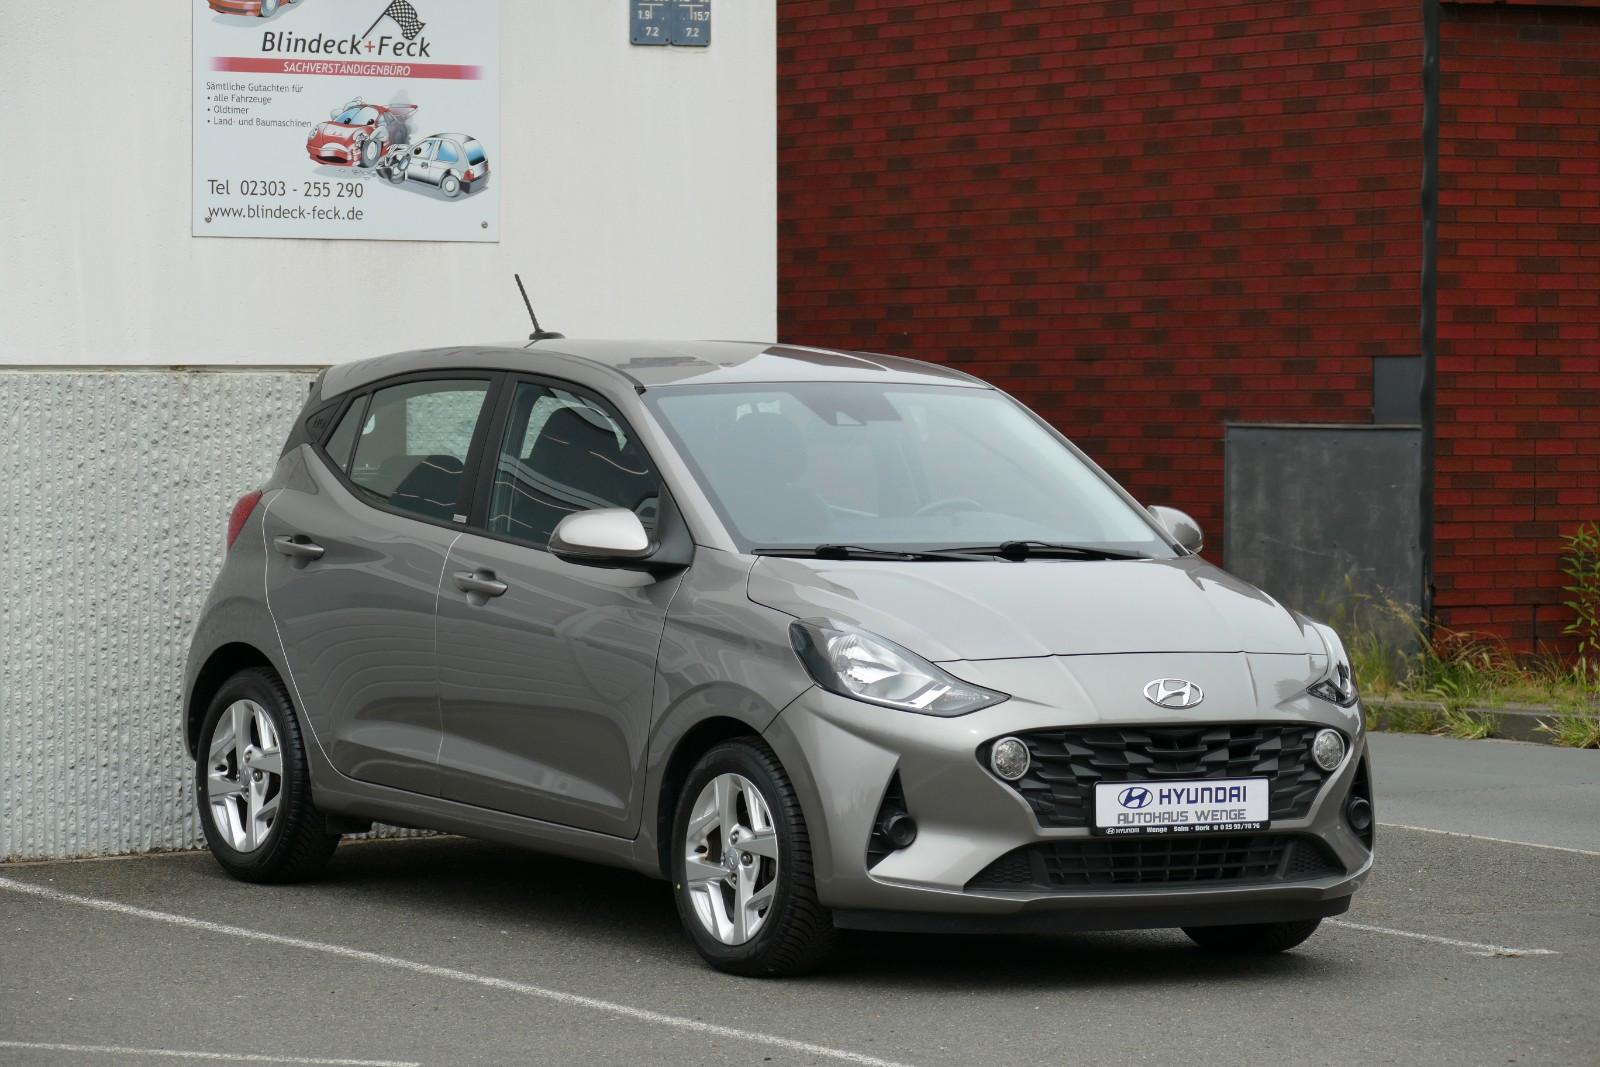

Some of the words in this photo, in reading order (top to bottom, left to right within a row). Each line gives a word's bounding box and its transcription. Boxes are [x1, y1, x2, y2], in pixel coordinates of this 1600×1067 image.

[283, 61, 411, 77] SACHVERSTÄNDIGENBÜRO
[206, 82, 246, 92] Sämtliche
[248, 83, 290, 93] Gutachten
[292, 84, 304, 93] für
[213, 94, 229, 103] alle
[231, 95, 272, 105] Fahrzeuge
[213, 105, 249, 115] Oldtimer
[238, 118, 254, 127] und
[256, 118, 312, 128] Baumaschinen
[208, 179, 231, 195] Tel
[240, 180, 286, 197] 02303
[303, 181, 331, 198] 255
[336, 182, 364, 198] 290
[208, 204, 364, 221] www.blindeck-feck.de
[1159, 785, 1247, 805] HYUNDAI
[1117, 811, 1189, 825] AUTOHAUS
[1195, 808, 1247, 821] WENGE
